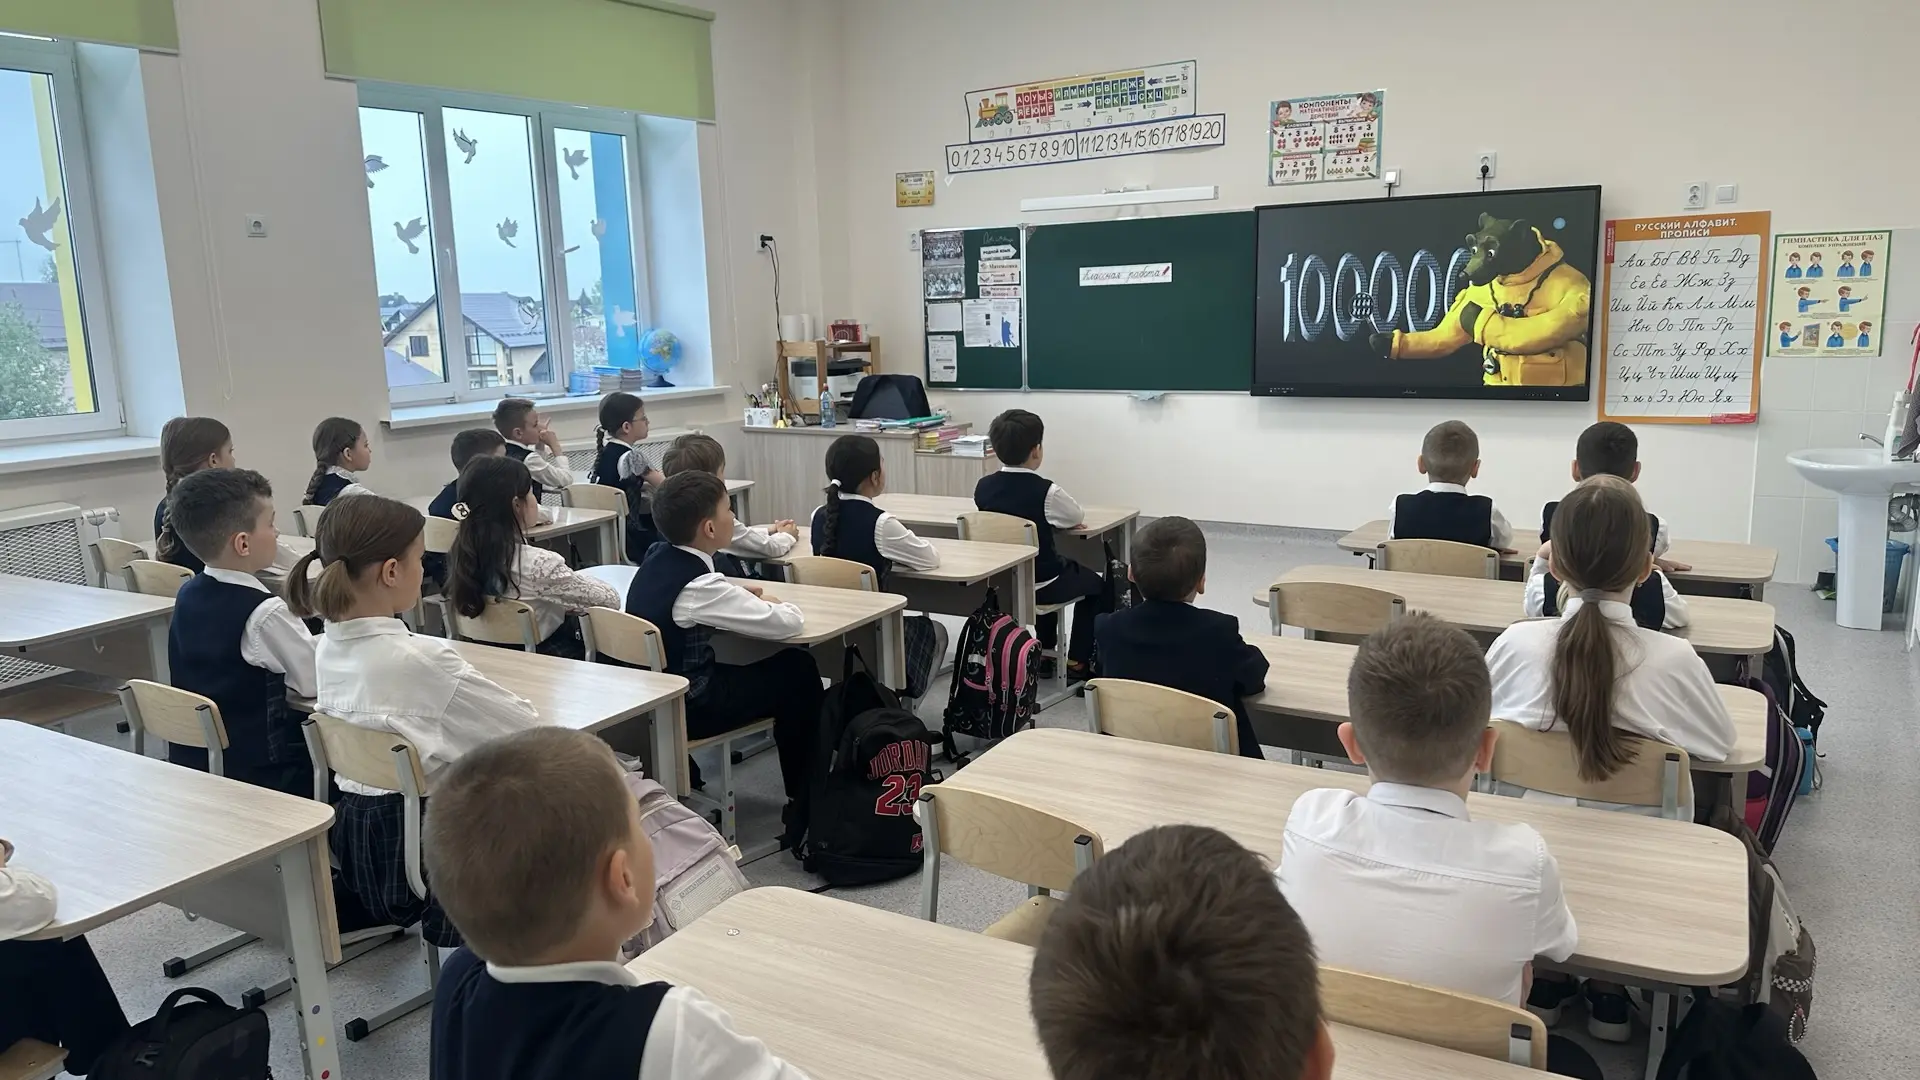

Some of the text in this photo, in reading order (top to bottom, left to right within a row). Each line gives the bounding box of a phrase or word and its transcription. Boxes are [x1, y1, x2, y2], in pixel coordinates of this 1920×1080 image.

[1298, 98, 1351, 109] КОМПОНЕНТЫ
[951, 120, 1221, 167] 0 1 2 3 4 5 6 7 8 9 10 11 12 13 14 15 16 17 18 19 20
[1634, 218, 1737, 232] РУССКИЙ АЛФАВИТ.
[1660, 229, 1710, 240] ПРОПИСИ
[1782, 235, 1839, 244] ГИМНАСТИКА
[1620, 248, 1750, 268] Аа Бб Вв Гг Дд
[1125, 265, 1160, 284] работа
[1630, 275, 1646, 290] Ее
[1673, 273, 1714, 288] Жж
[1718, 272, 1736, 292] Зз
[1610, 294, 1755, 312] Ии Йй Кк Лл Мм
[1628, 316, 1734, 335] Нн Оо Пп Рр
[1612, 341, 1748, 362] Сс Тт Уу Фф Хх
[1618, 365, 1740, 383] Цц Чч Шш Щщ
[1656, 389, 1674, 403] Ээ
[1678, 389, 1705, 403] Юю
[1709, 389, 1734, 403] Яя
[875, 772, 922, 817] 23
